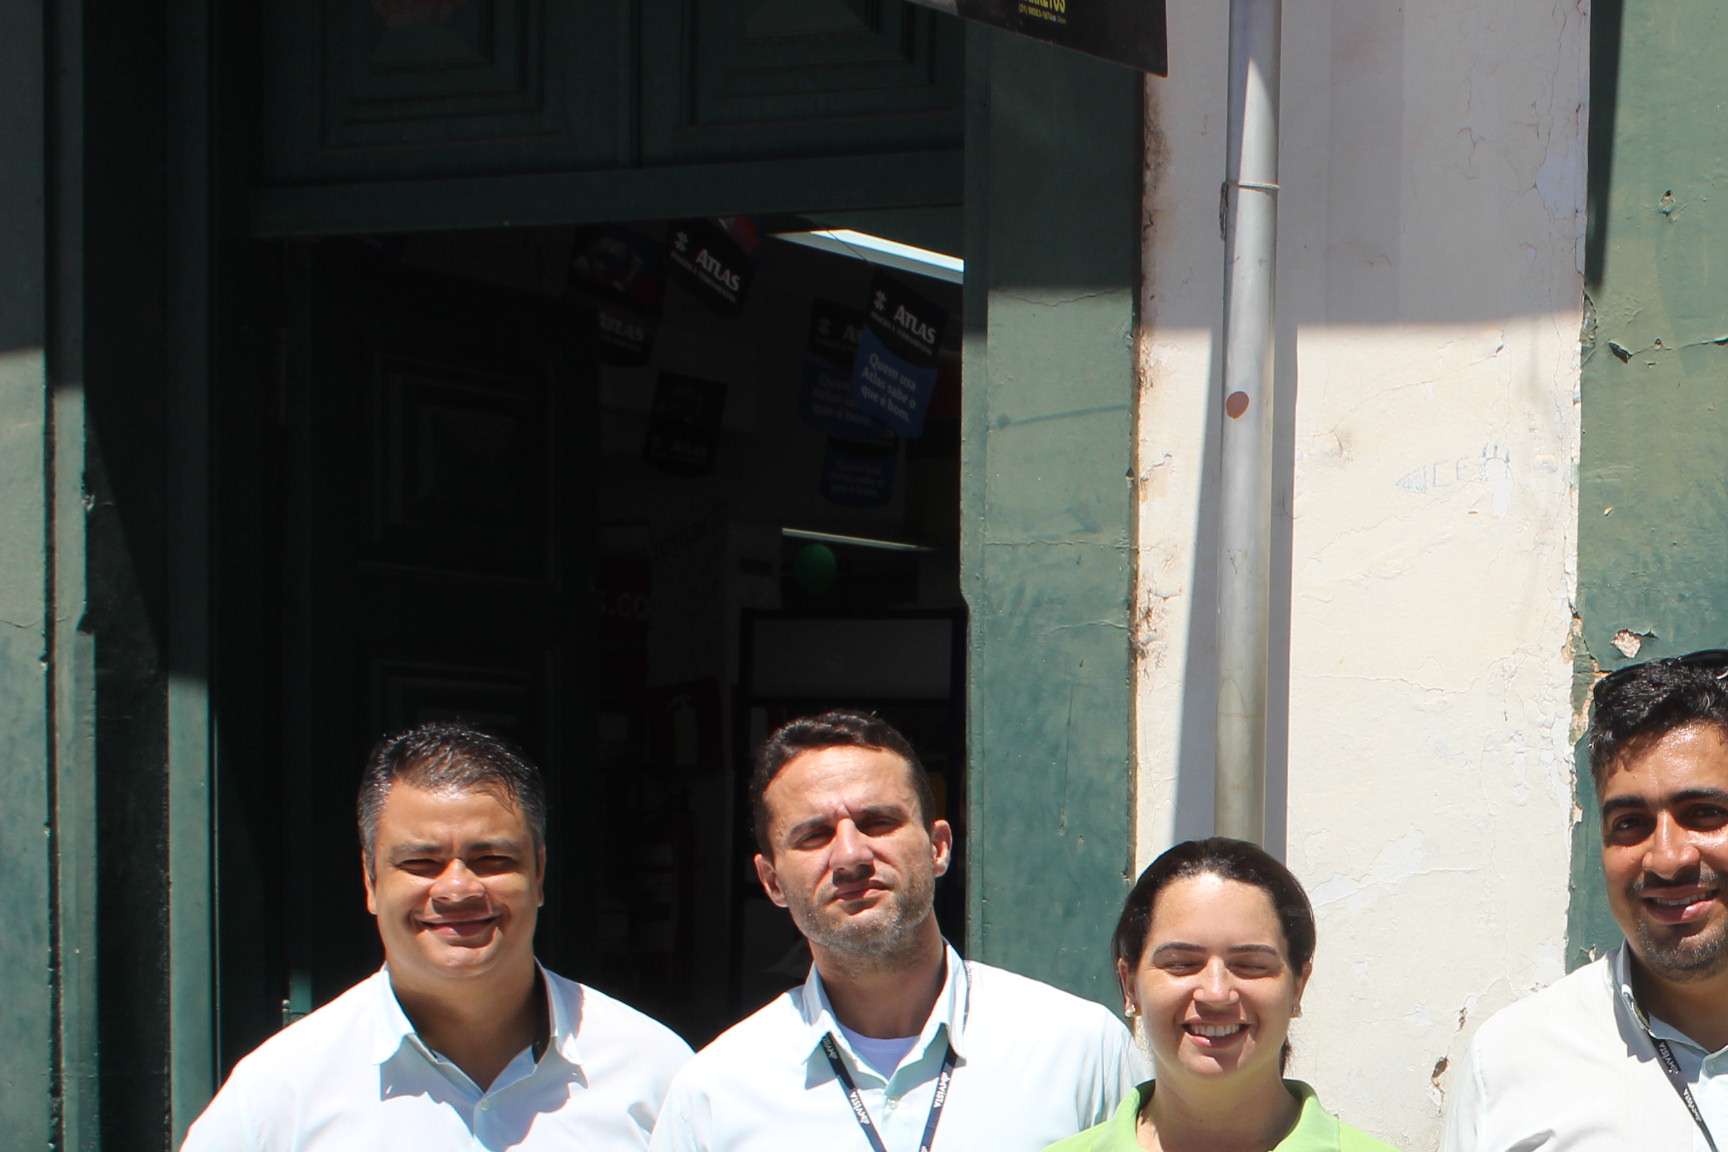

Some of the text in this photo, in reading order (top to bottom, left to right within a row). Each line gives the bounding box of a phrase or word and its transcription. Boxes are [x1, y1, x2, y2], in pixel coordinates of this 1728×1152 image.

[695, 247, 742, 293] ATLAS
[893, 304, 937, 345] ATLAS
[868, 353, 899, 382] Quem
